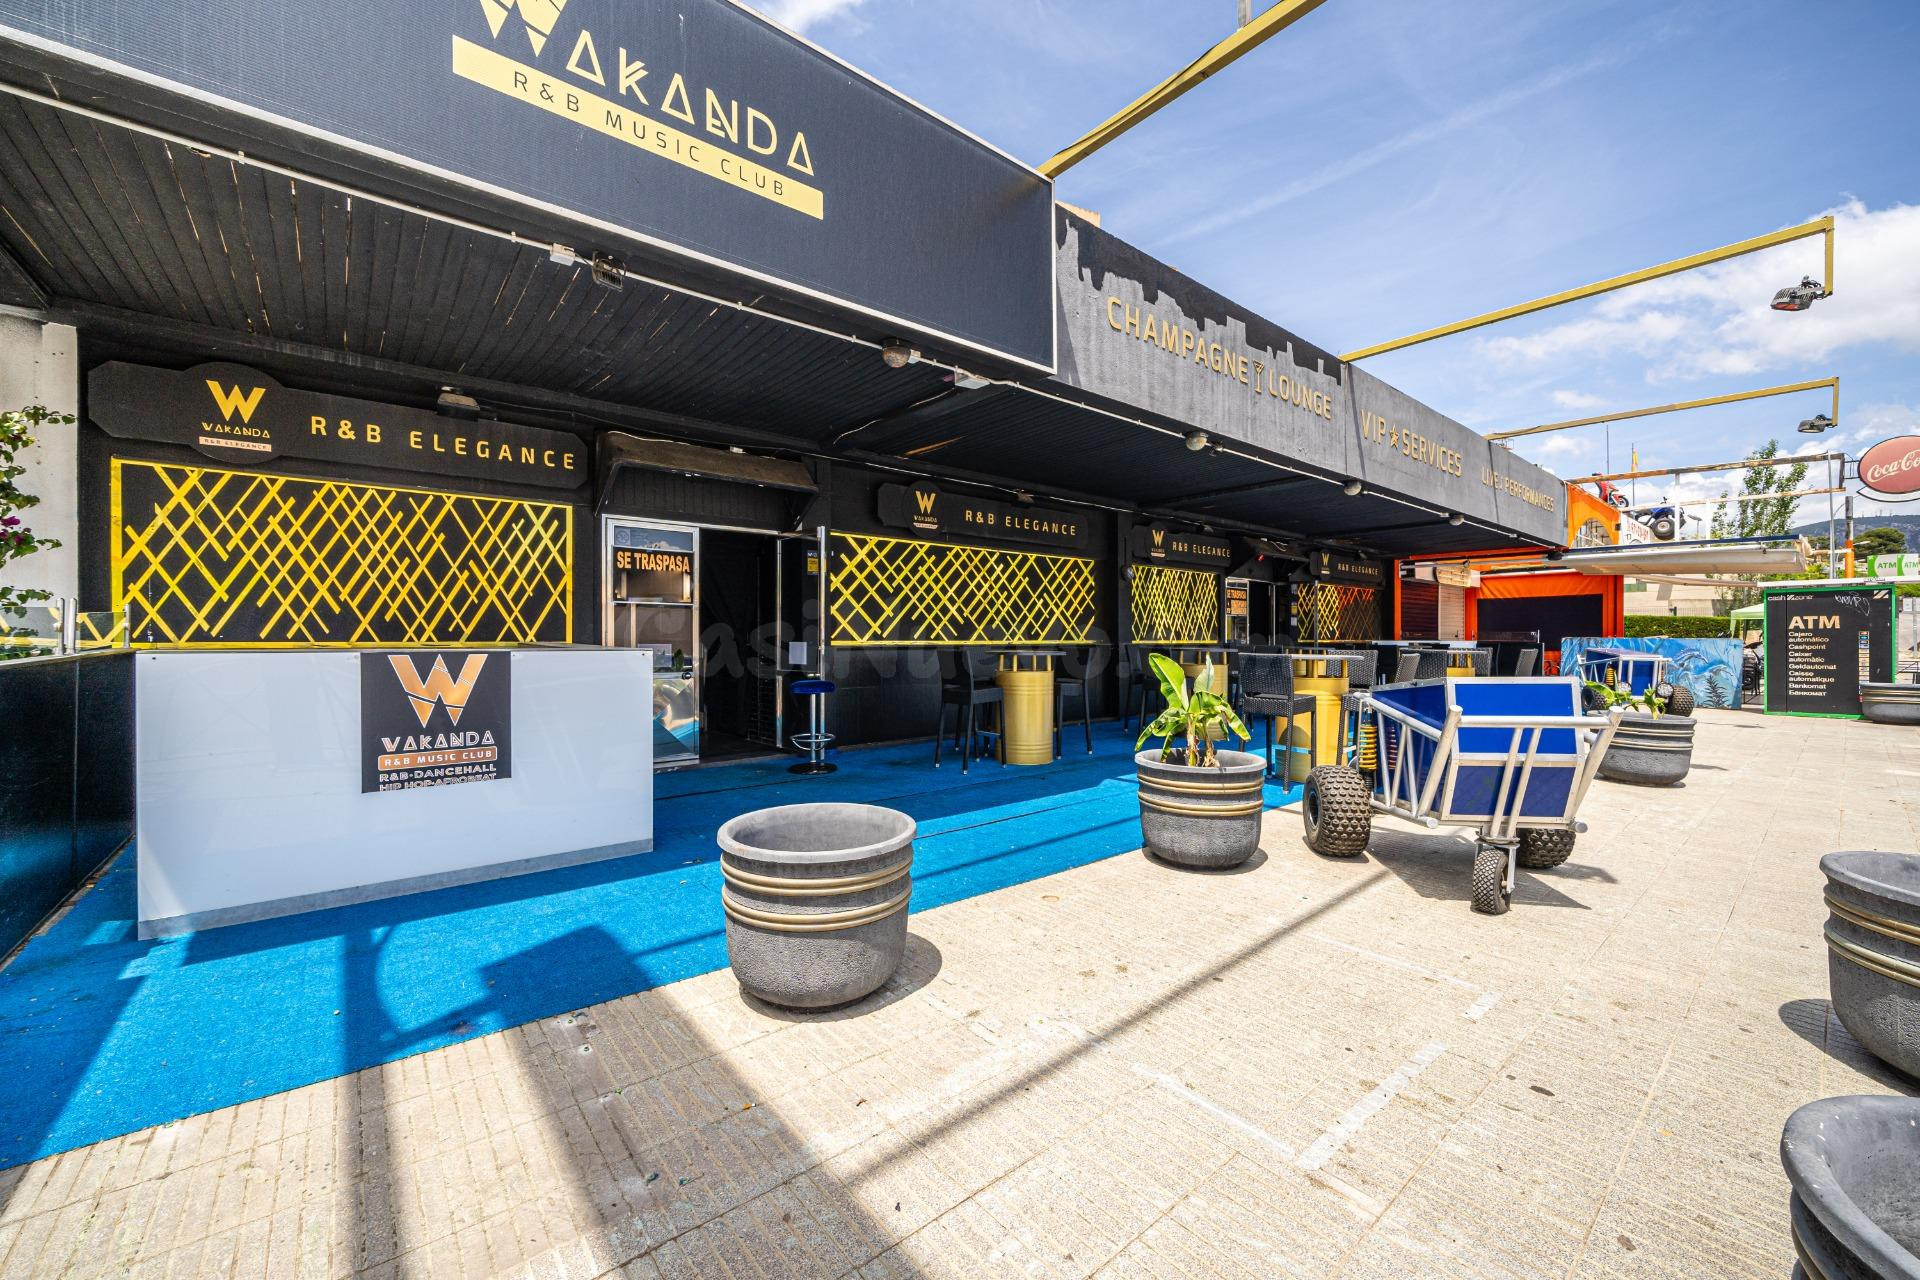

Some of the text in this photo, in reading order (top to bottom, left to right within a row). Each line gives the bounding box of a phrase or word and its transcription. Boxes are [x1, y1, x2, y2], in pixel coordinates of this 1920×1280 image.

[513, 70, 784, 196] R&B MUSIC CLUB
[1106, 296, 1332, 420] CHAMPAGNE LOUNGE
[201, 421, 271, 439] WAKANDA
[311, 415, 575, 470] R&B ELEGANCE
[1360, 408, 1463, 478] VIP SERVICES
[965, 509, 1077, 536] R&B ELEGANCE
[616, 551, 691, 573] SE TRASPASA
[1192, 544, 1231, 558] ELEGANCE
[1877, 561, 1897, 569] ATM
[1788, 615, 1841, 629] ATM
[381, 730, 495, 752] WAKANDA
[384, 750, 492, 767] R&B MUSIC CLUB
